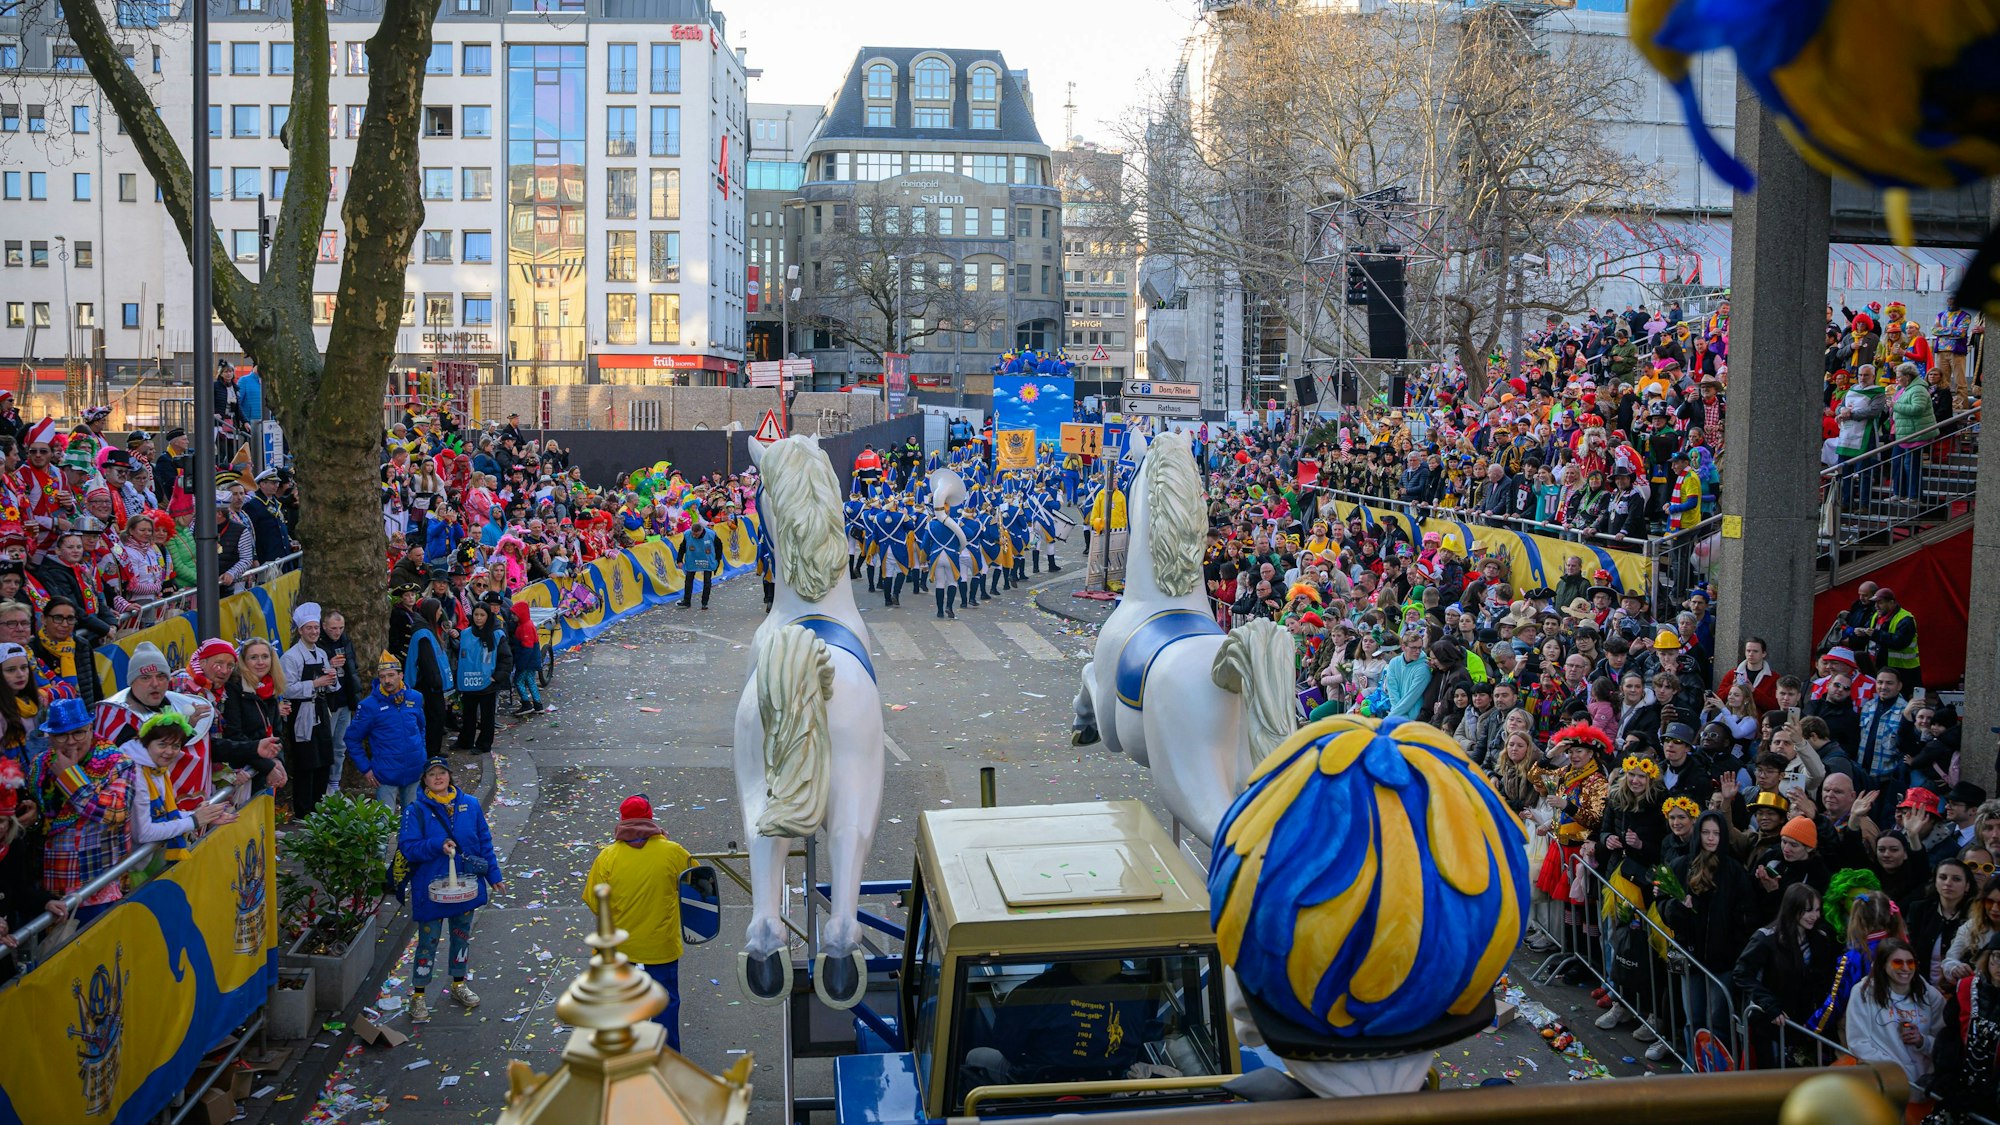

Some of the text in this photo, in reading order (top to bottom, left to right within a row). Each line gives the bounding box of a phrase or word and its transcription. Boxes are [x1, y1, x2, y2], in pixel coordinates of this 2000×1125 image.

[671, 24, 703, 41] früh
[901, 179, 939, 189] rheingold
[921, 191, 964, 204] salon
[422, 333, 492, 342] EDEN HOTEL
[653, 355, 674, 368] früh
[1158, 386, 1191, 395] Dom/Rhein
[1158, 404, 1181, 412] Rathaus
[1516, 489, 1528, 510] 8
[140, 664, 157, 675] früh
[1615, 954, 1638, 968] MSCH
[1070, 999, 1105, 1010] Bürgergarde
